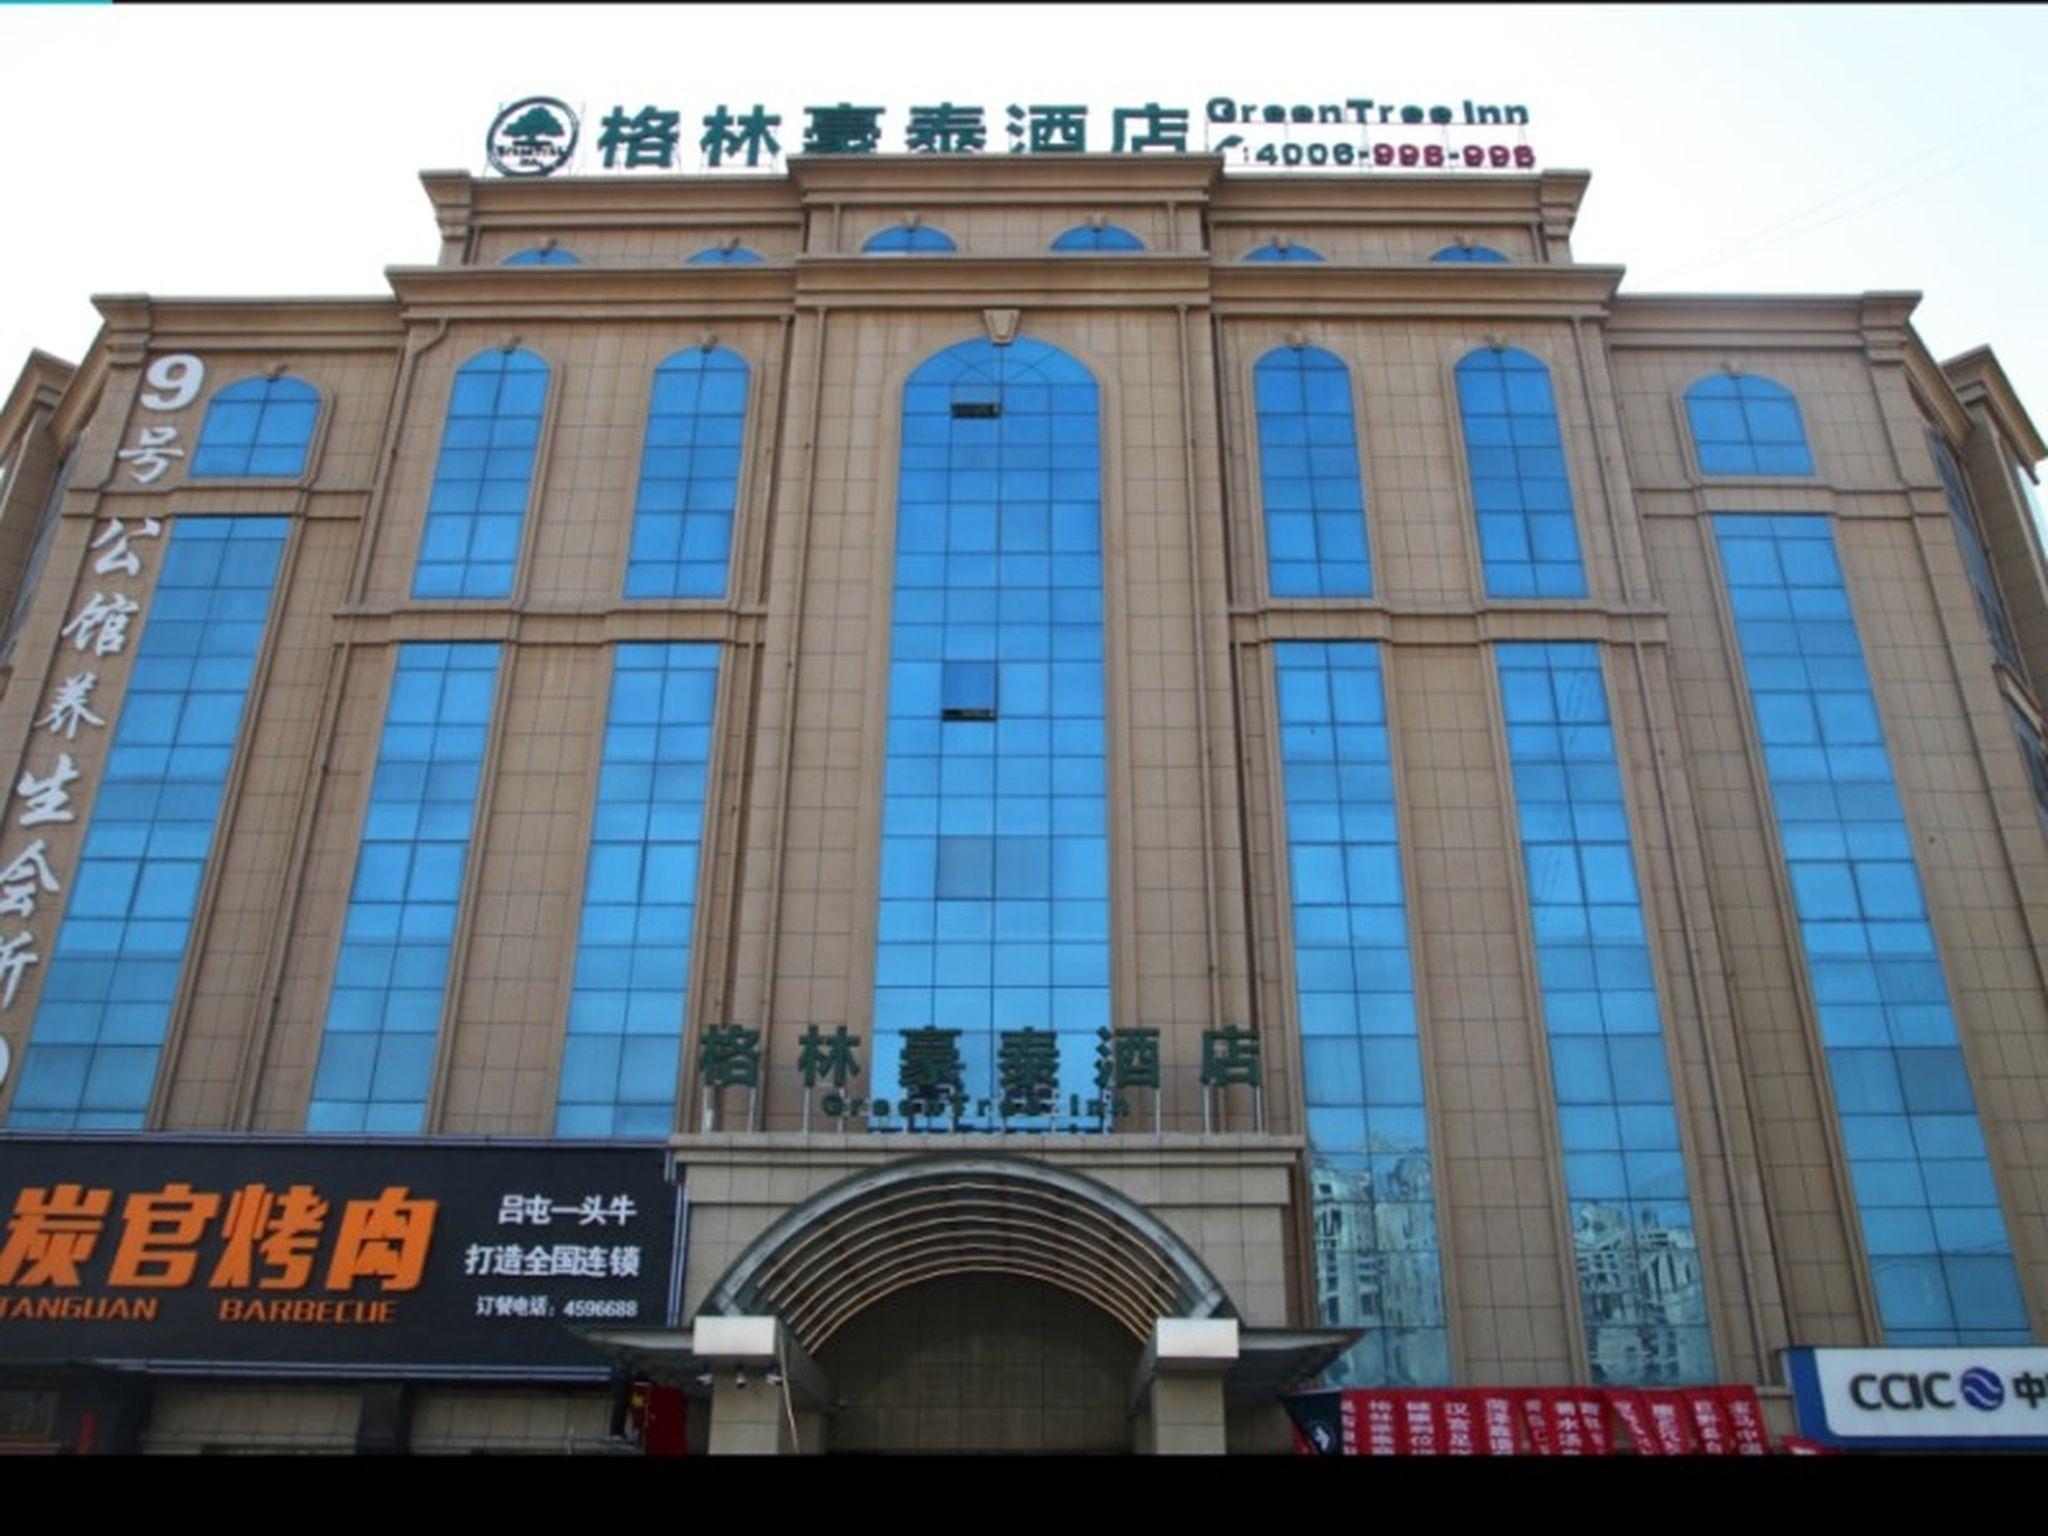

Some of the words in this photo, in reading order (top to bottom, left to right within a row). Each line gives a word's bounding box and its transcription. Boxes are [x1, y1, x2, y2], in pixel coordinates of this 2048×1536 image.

[1463, 100, 1529, 125] Inn
[597, 102, 1189, 167] 格林豪泰酒店
[700, 1025, 1261, 1094] 格林豪泰酒店
[498, 1193, 637, 1226] 吕屯一头牛
[0, 1183, 439, 1290] 炭官烤肉
[465, 1243, 641, 1277] 打造全国连锁
[218, 1299, 398, 1324] BARBECUE
[1850, 1372, 1956, 1411] CCIC
[2012, 1371, 2048, 1410] 中
